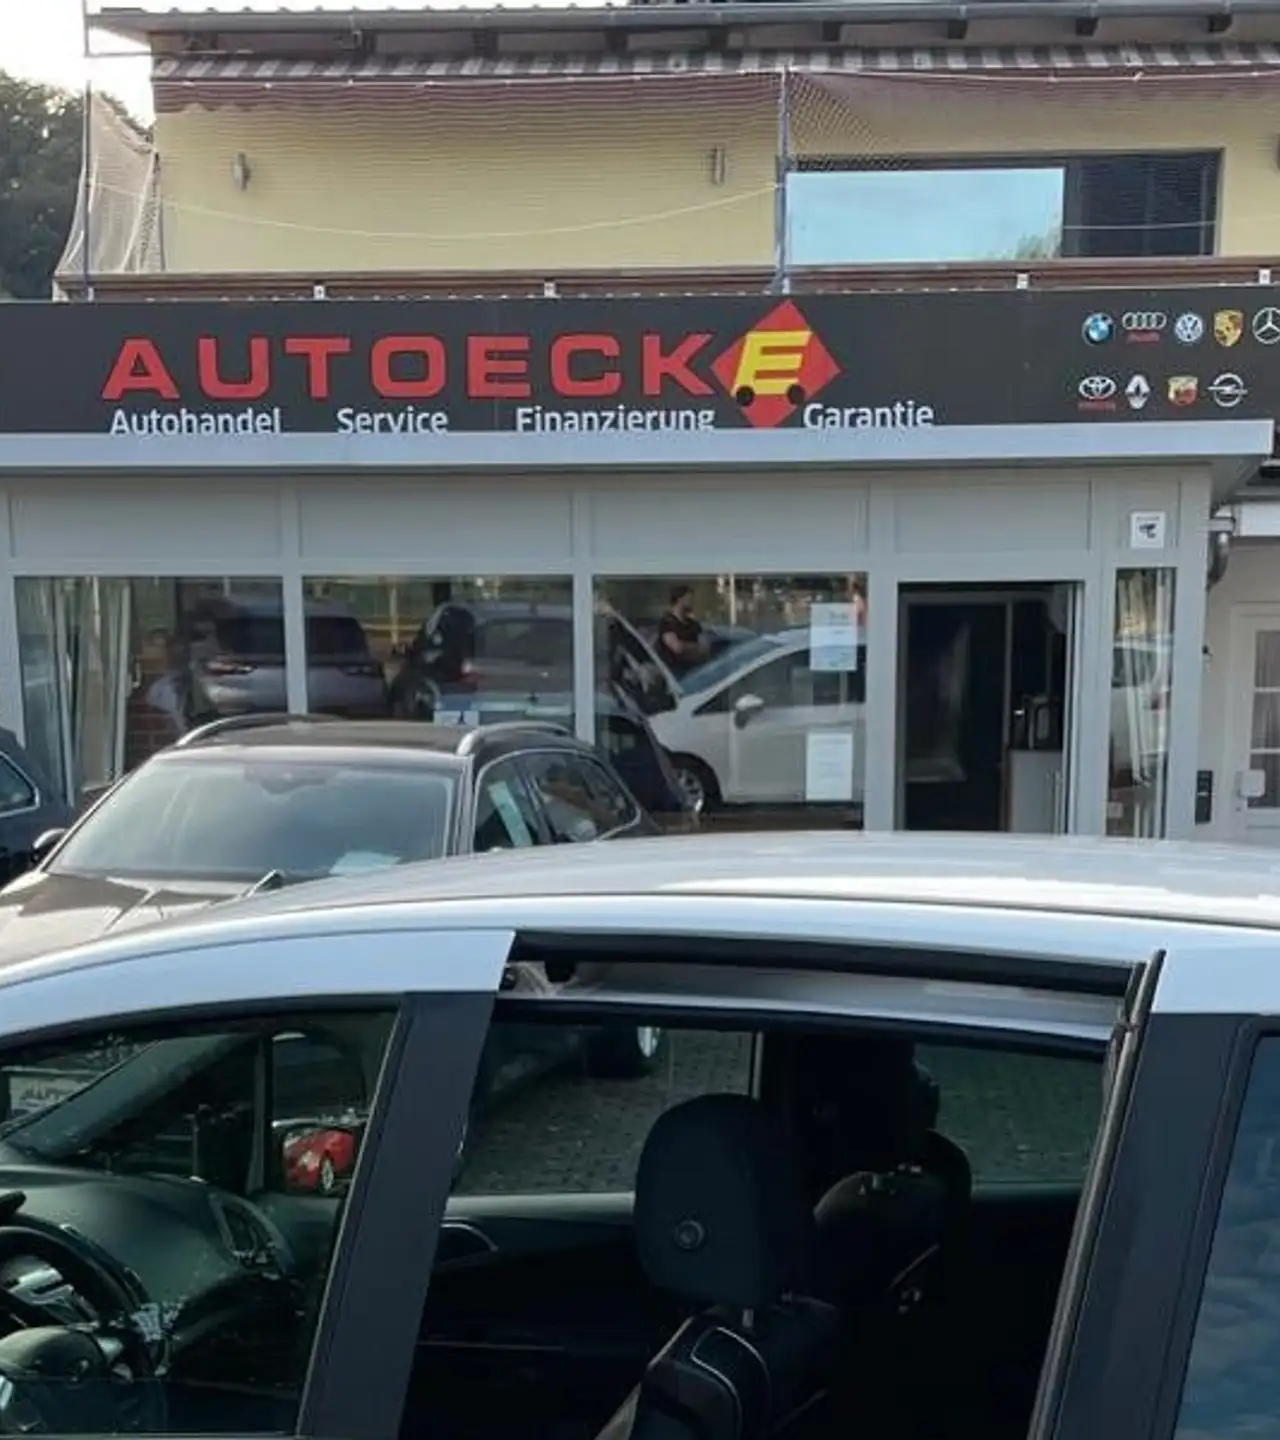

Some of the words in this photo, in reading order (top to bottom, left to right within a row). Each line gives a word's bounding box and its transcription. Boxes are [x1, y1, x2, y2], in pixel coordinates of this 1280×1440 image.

[102, 333, 715, 400] AUTOECK
[109, 407, 281, 435] Autohandel
[336, 405, 449, 434] Service
[516, 404, 716, 432] Finanzierung
[803, 400, 935, 429] Garantie
